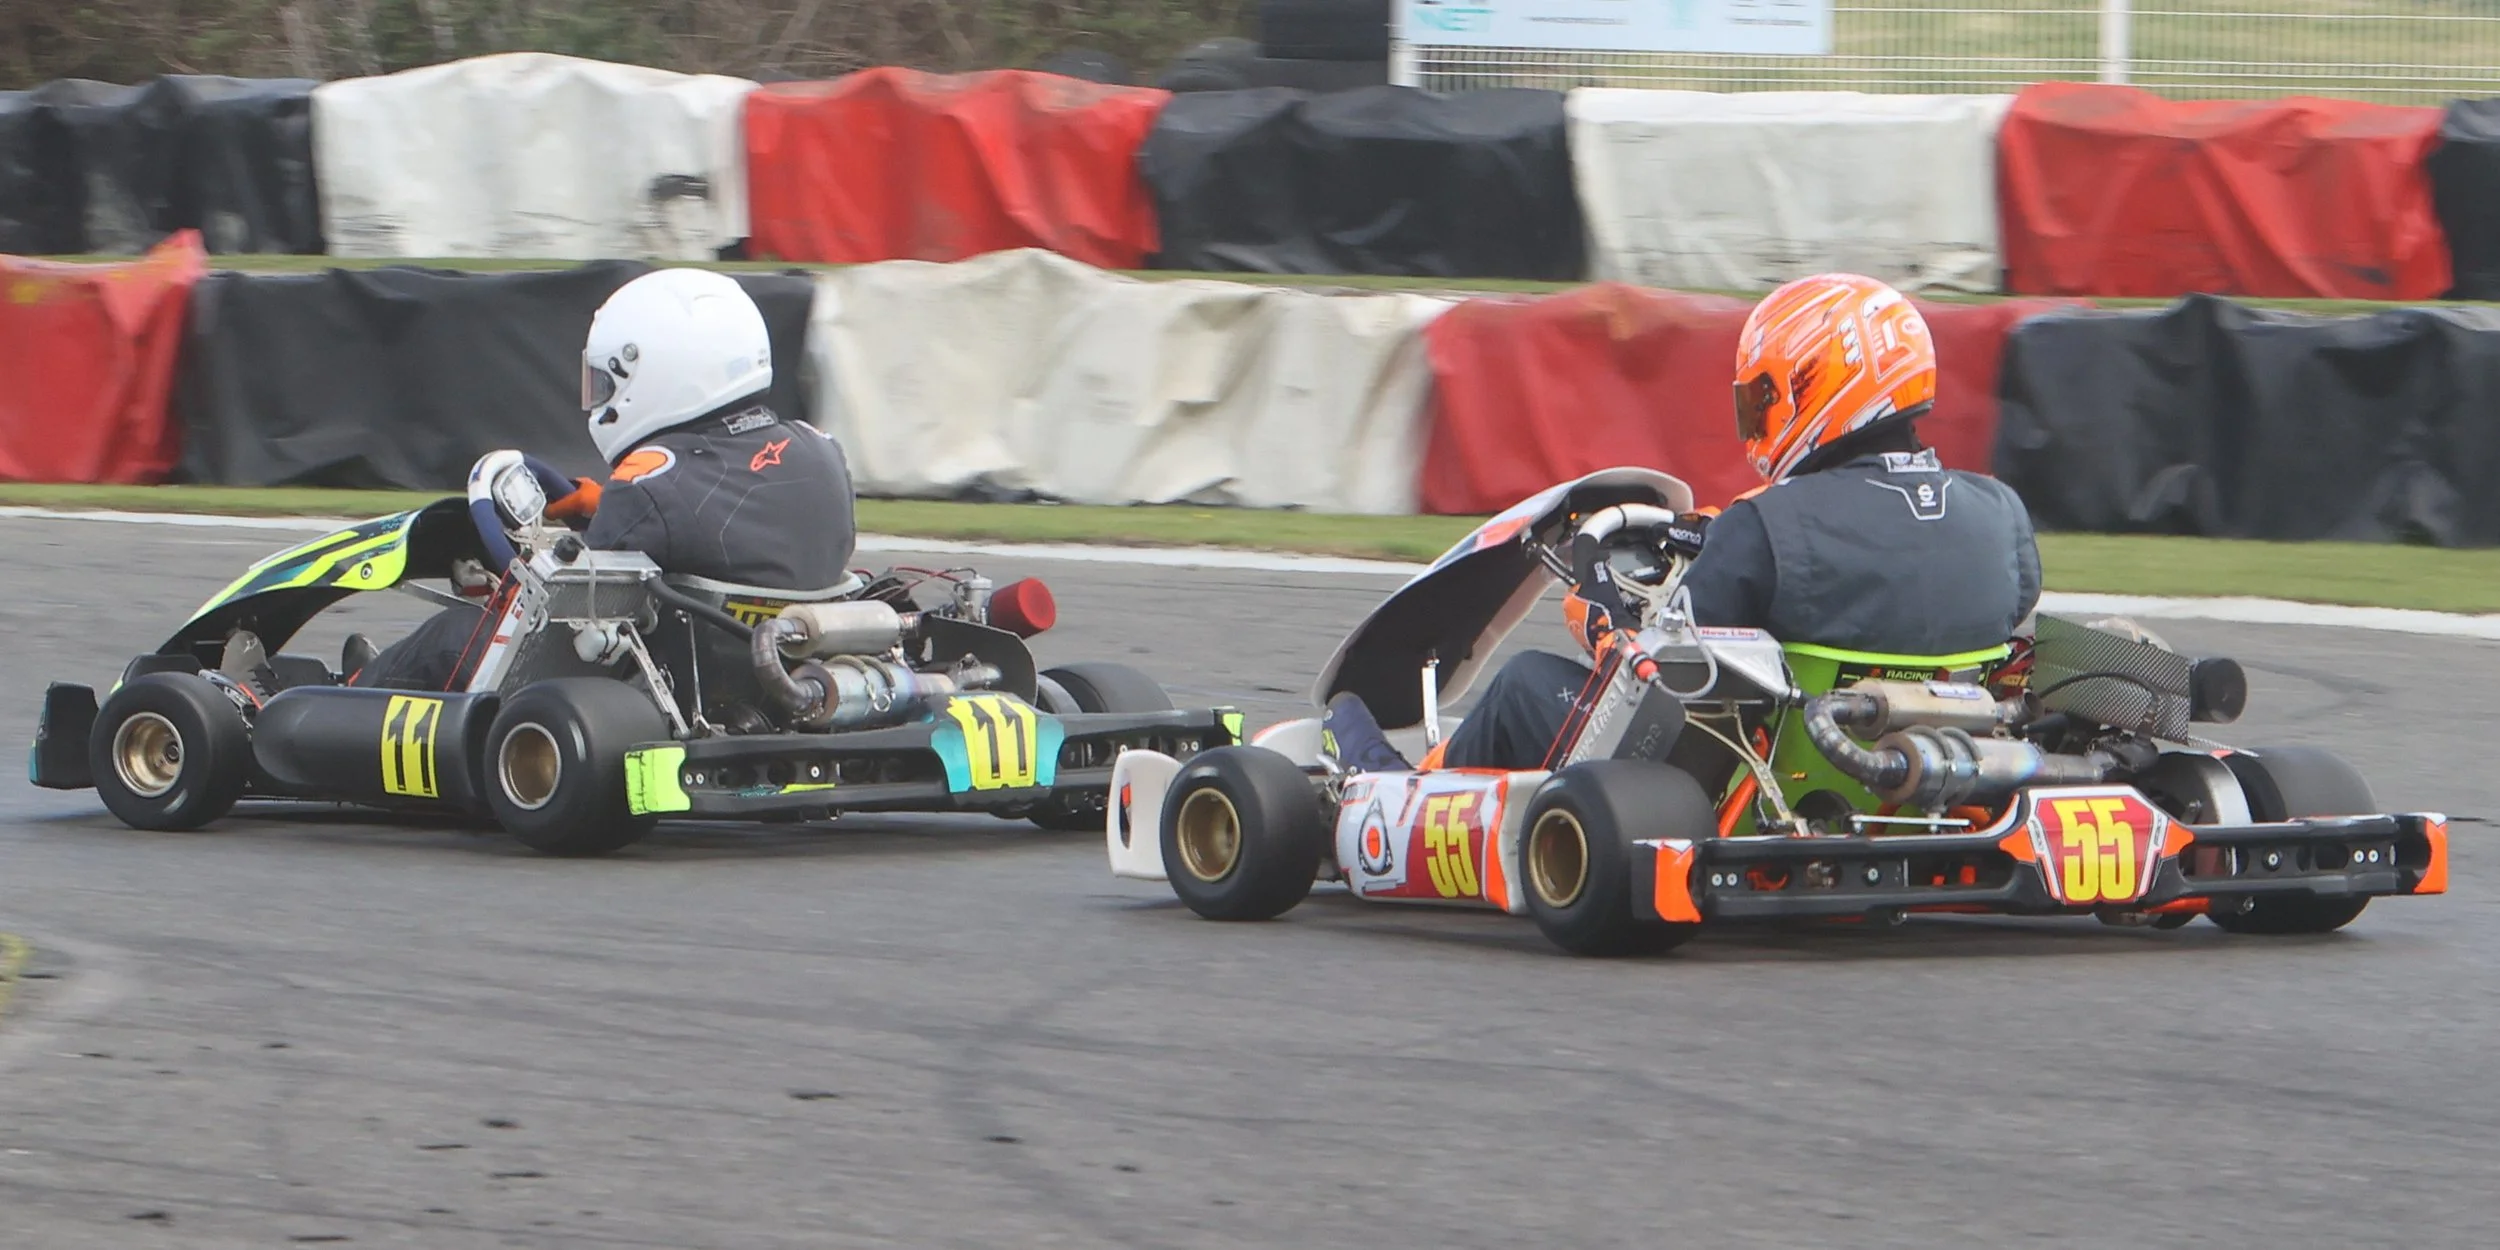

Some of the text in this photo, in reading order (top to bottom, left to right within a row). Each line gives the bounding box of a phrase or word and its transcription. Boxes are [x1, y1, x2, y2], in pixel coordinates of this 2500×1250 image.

[1668, 527, 1702, 545] sparco
[1886, 669, 1934, 681] RACING
[387, 700, 437, 794] 11
[968, 699, 1028, 779] 11
[1424, 792, 1479, 898] 55
[2052, 797, 2137, 901] 55
